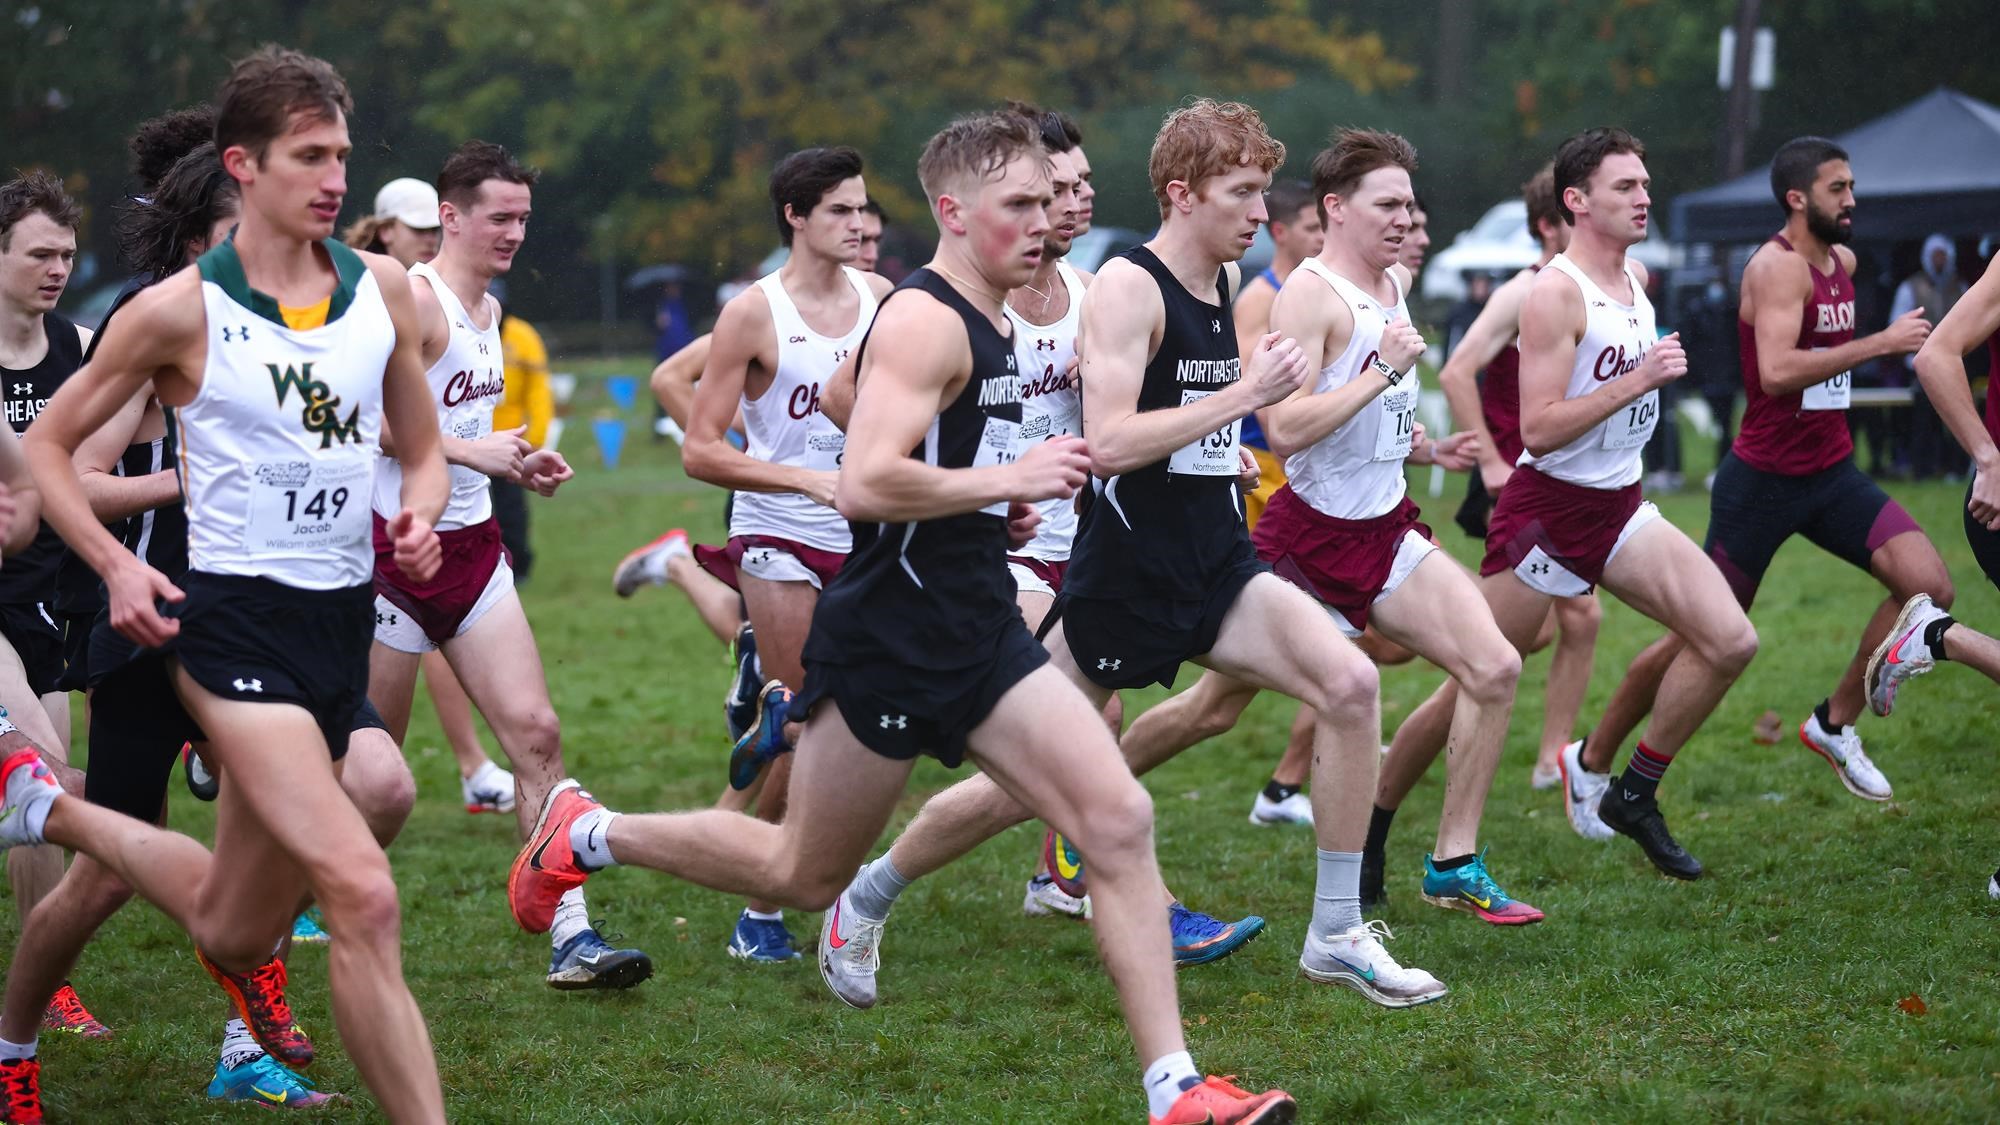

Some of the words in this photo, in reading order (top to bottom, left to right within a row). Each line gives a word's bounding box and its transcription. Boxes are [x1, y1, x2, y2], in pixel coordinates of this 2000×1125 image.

[1629, 398, 1656, 427] 104
[1202, 449, 1226, 459] Patrick
[284, 487, 349, 521] 149
[293, 522, 332, 535] Jacob
[266, 538, 304, 549] William
[307, 537, 327, 548] and
